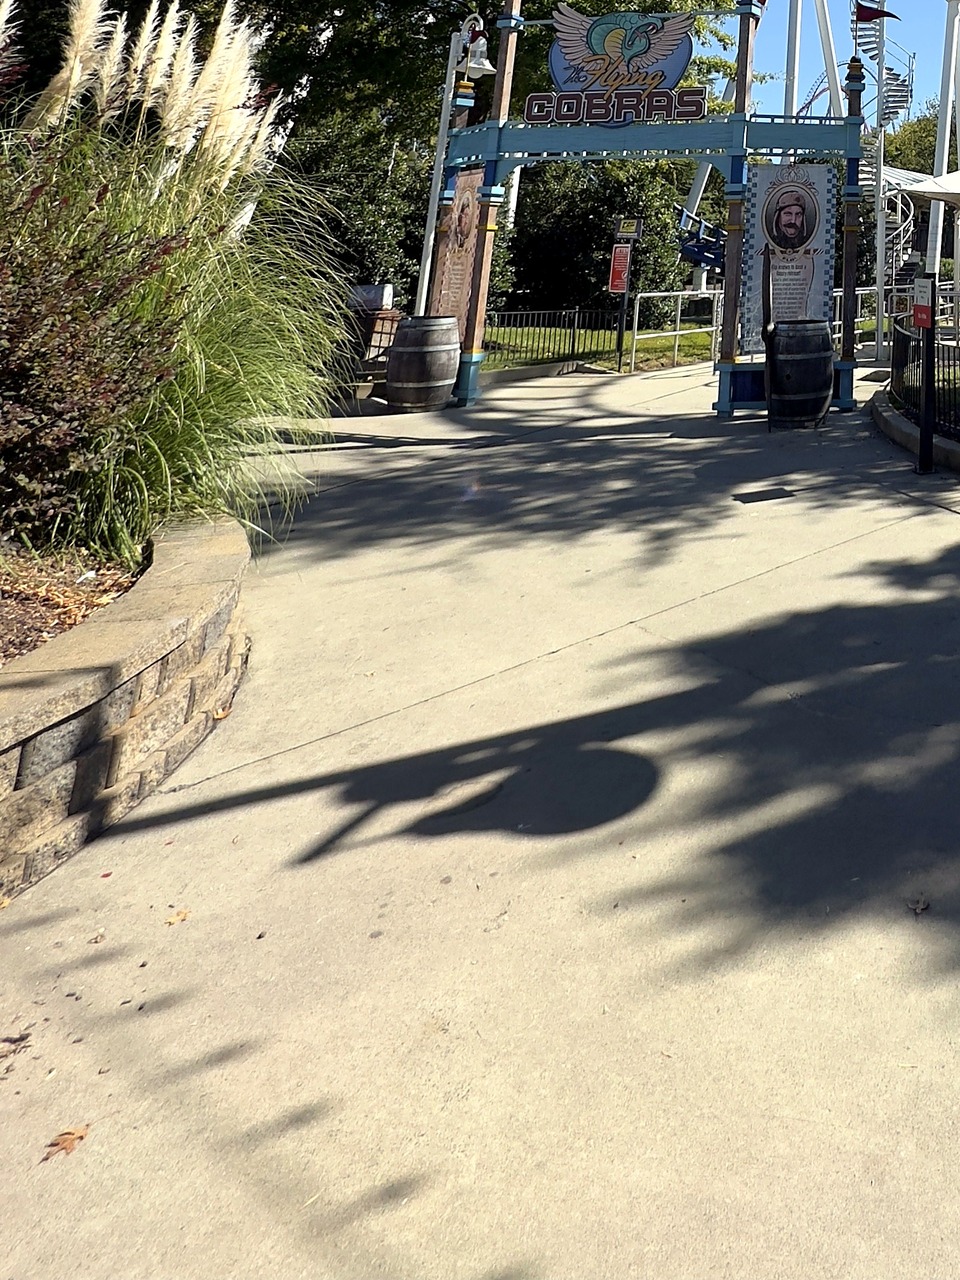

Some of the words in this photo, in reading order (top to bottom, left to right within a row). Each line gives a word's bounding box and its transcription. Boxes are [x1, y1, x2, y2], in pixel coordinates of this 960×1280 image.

[564, 66, 588, 86] The
[581, 54, 666, 101] Flying
[524, 87, 707, 124] COBRAS
